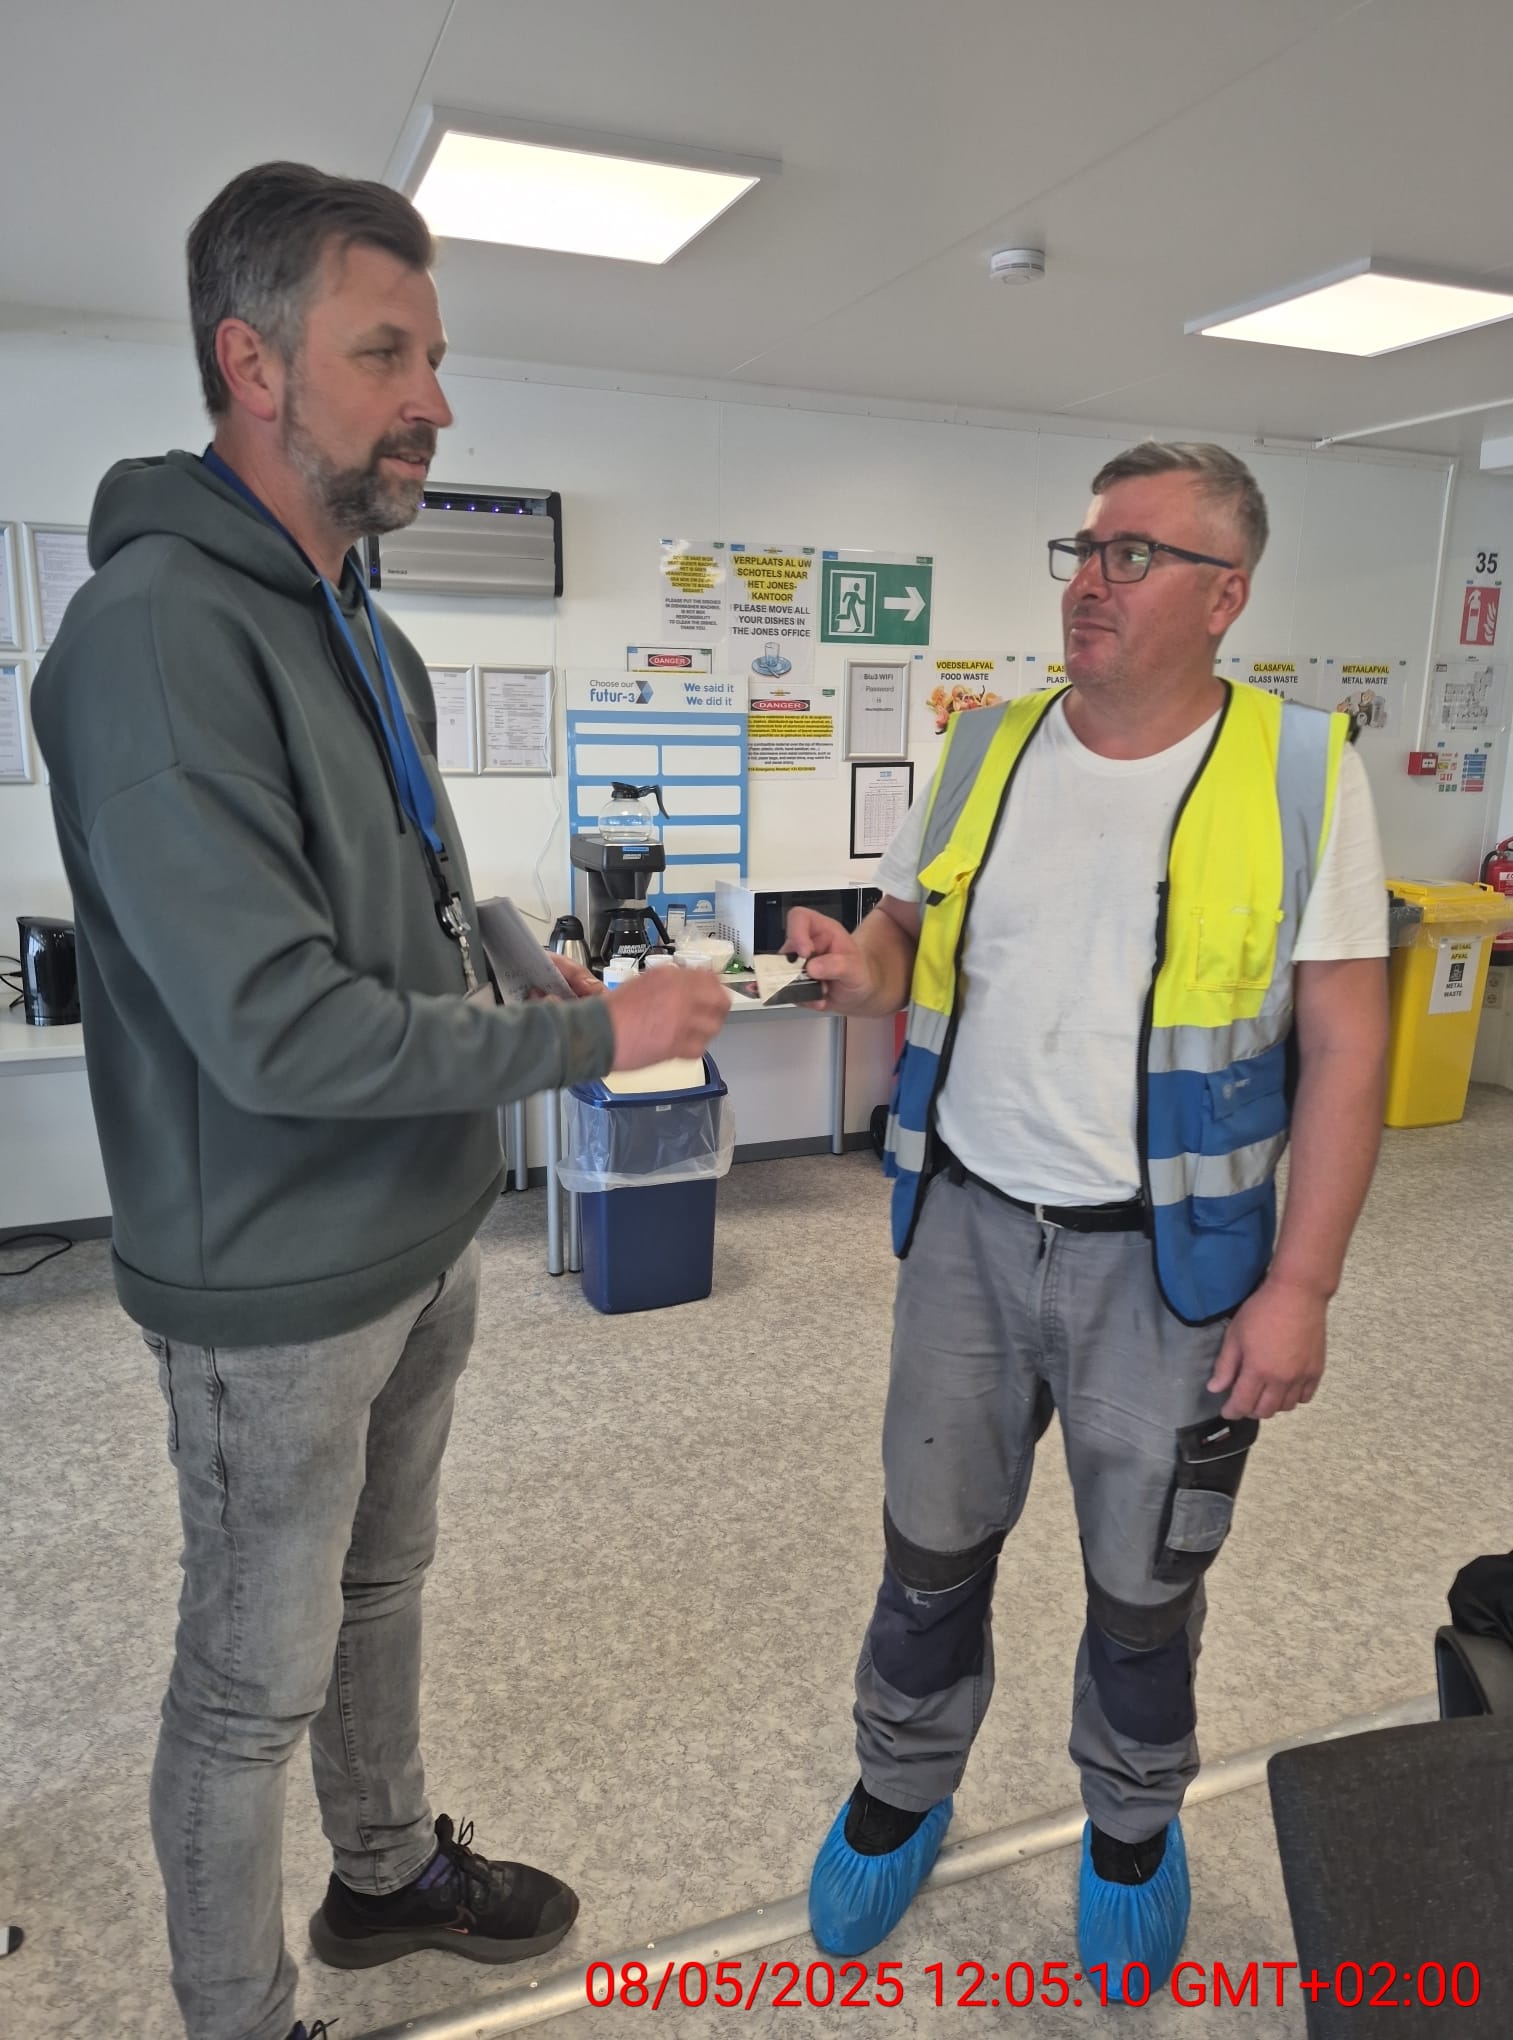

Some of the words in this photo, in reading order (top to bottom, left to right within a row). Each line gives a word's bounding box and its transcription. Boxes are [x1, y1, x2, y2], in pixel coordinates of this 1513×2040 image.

[734, 556, 783, 566] VERPLAATS
[785, 559, 796, 567] AL
[798, 560, 812, 568] UW
[1475, 552, 1498, 574] 35
[737, 568, 782, 578] SCHOTELS
[785, 571, 808, 579] NAAR
[767, 582, 797, 590] JONES-
[752, 592, 793, 601] KANTOOR
[733, 604, 767, 613] PLEASE
[739, 616, 763, 624] YOUR
[765, 617, 795, 625] DISHES
[732, 627, 749, 635] THE
[751, 628, 779, 636] JONES
[781, 629, 811, 637] OFFICE
[654, 657, 686, 665] DANGER
[936, 661, 994, 670] VOEDSELAFVAL
[1254, 663, 1295, 672] GLASAFVAL
[1342, 665, 1390, 674] METAALAFVAL
[963, 673, 989, 681] WASTE
[1248, 675, 1272, 684] GLASS
[1273, 675, 1298, 684] WASTE
[1364, 677, 1388, 685] WASTE
[589, 680, 620, 688] Choose
[684, 683, 700, 692] We
[704, 683, 724, 692] said
[727, 684, 734, 693] it
[590, 688, 635, 703] futur-3
[686, 696, 703, 705] We
[705, 697, 722, 706] did
[725, 697, 732, 706] it
[759, 701, 801, 710] DANGER
